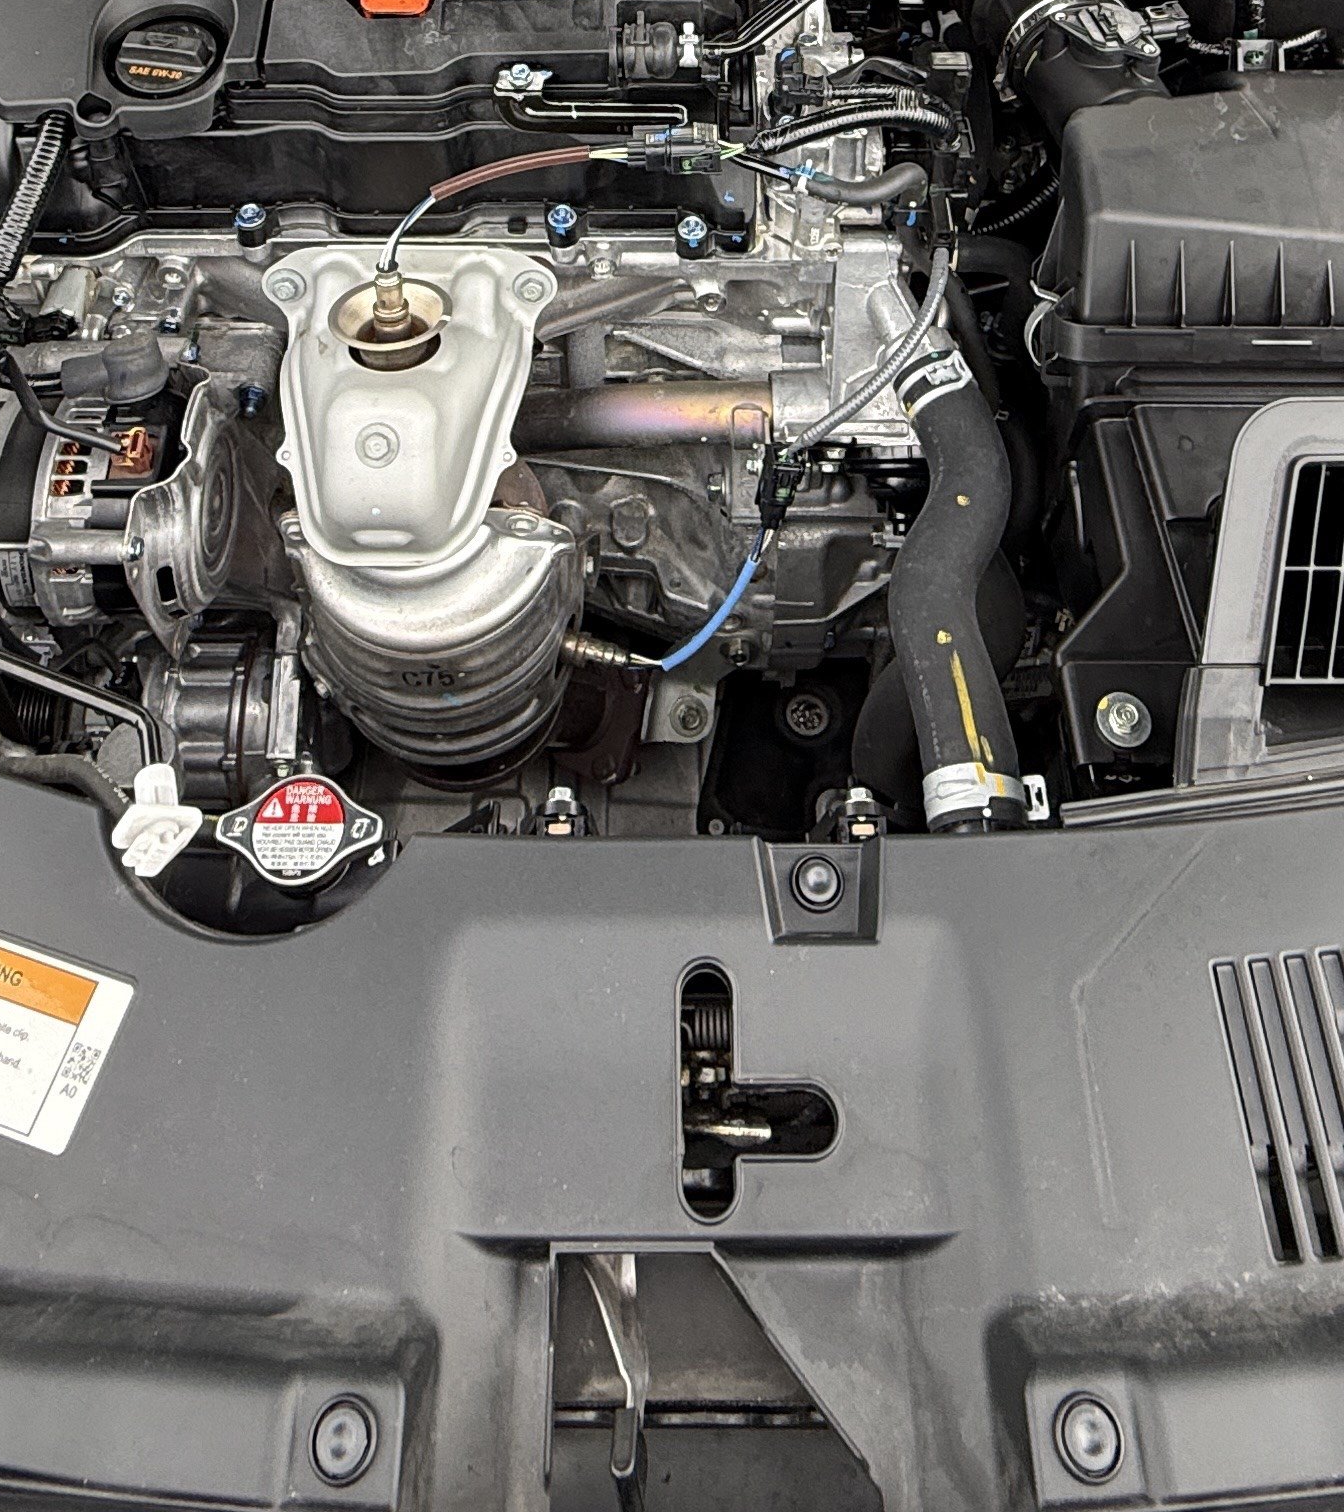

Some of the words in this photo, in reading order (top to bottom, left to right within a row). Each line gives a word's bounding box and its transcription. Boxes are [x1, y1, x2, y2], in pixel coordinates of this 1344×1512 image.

[128, 65, 151, 76] SAE
[401, 670, 455, 687] C75
[59, 1082, 78, 1099] A0
